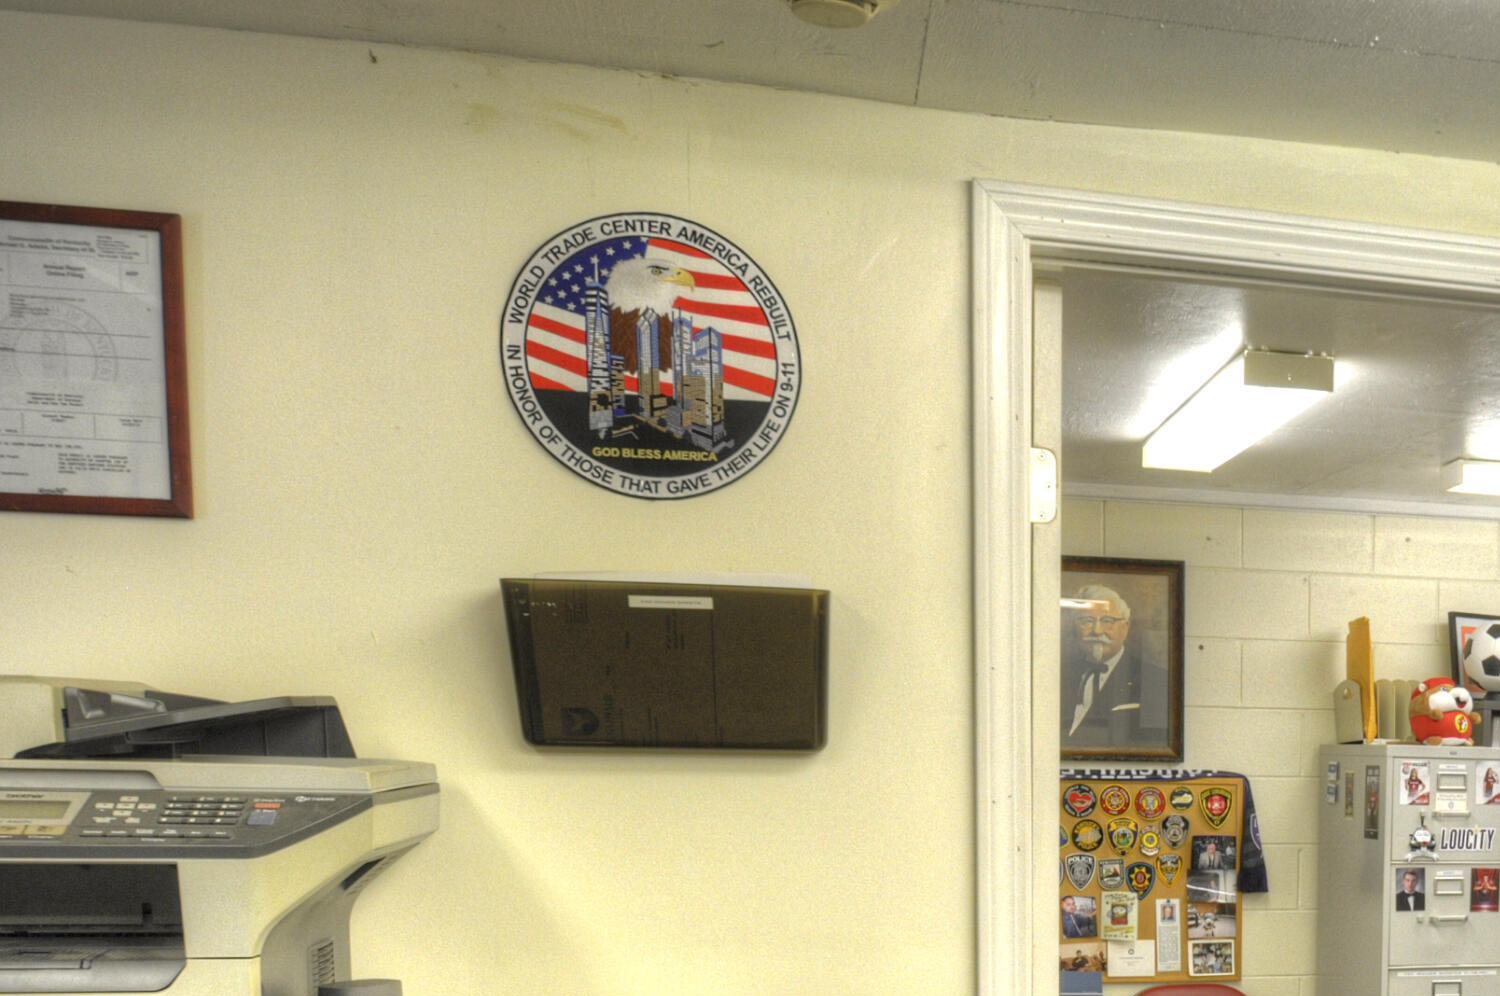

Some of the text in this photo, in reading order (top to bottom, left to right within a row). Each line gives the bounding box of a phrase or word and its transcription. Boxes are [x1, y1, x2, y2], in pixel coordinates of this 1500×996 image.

[508, 218, 793, 342] WORLD TRADE CENTER AMERICA REBUILT
[506, 344, 796, 495] IN HONOR OF THOSE THAT GAVE THEIR LIFE ON 9-11
[592, 447, 718, 463] GOD BLESS AMERICA
